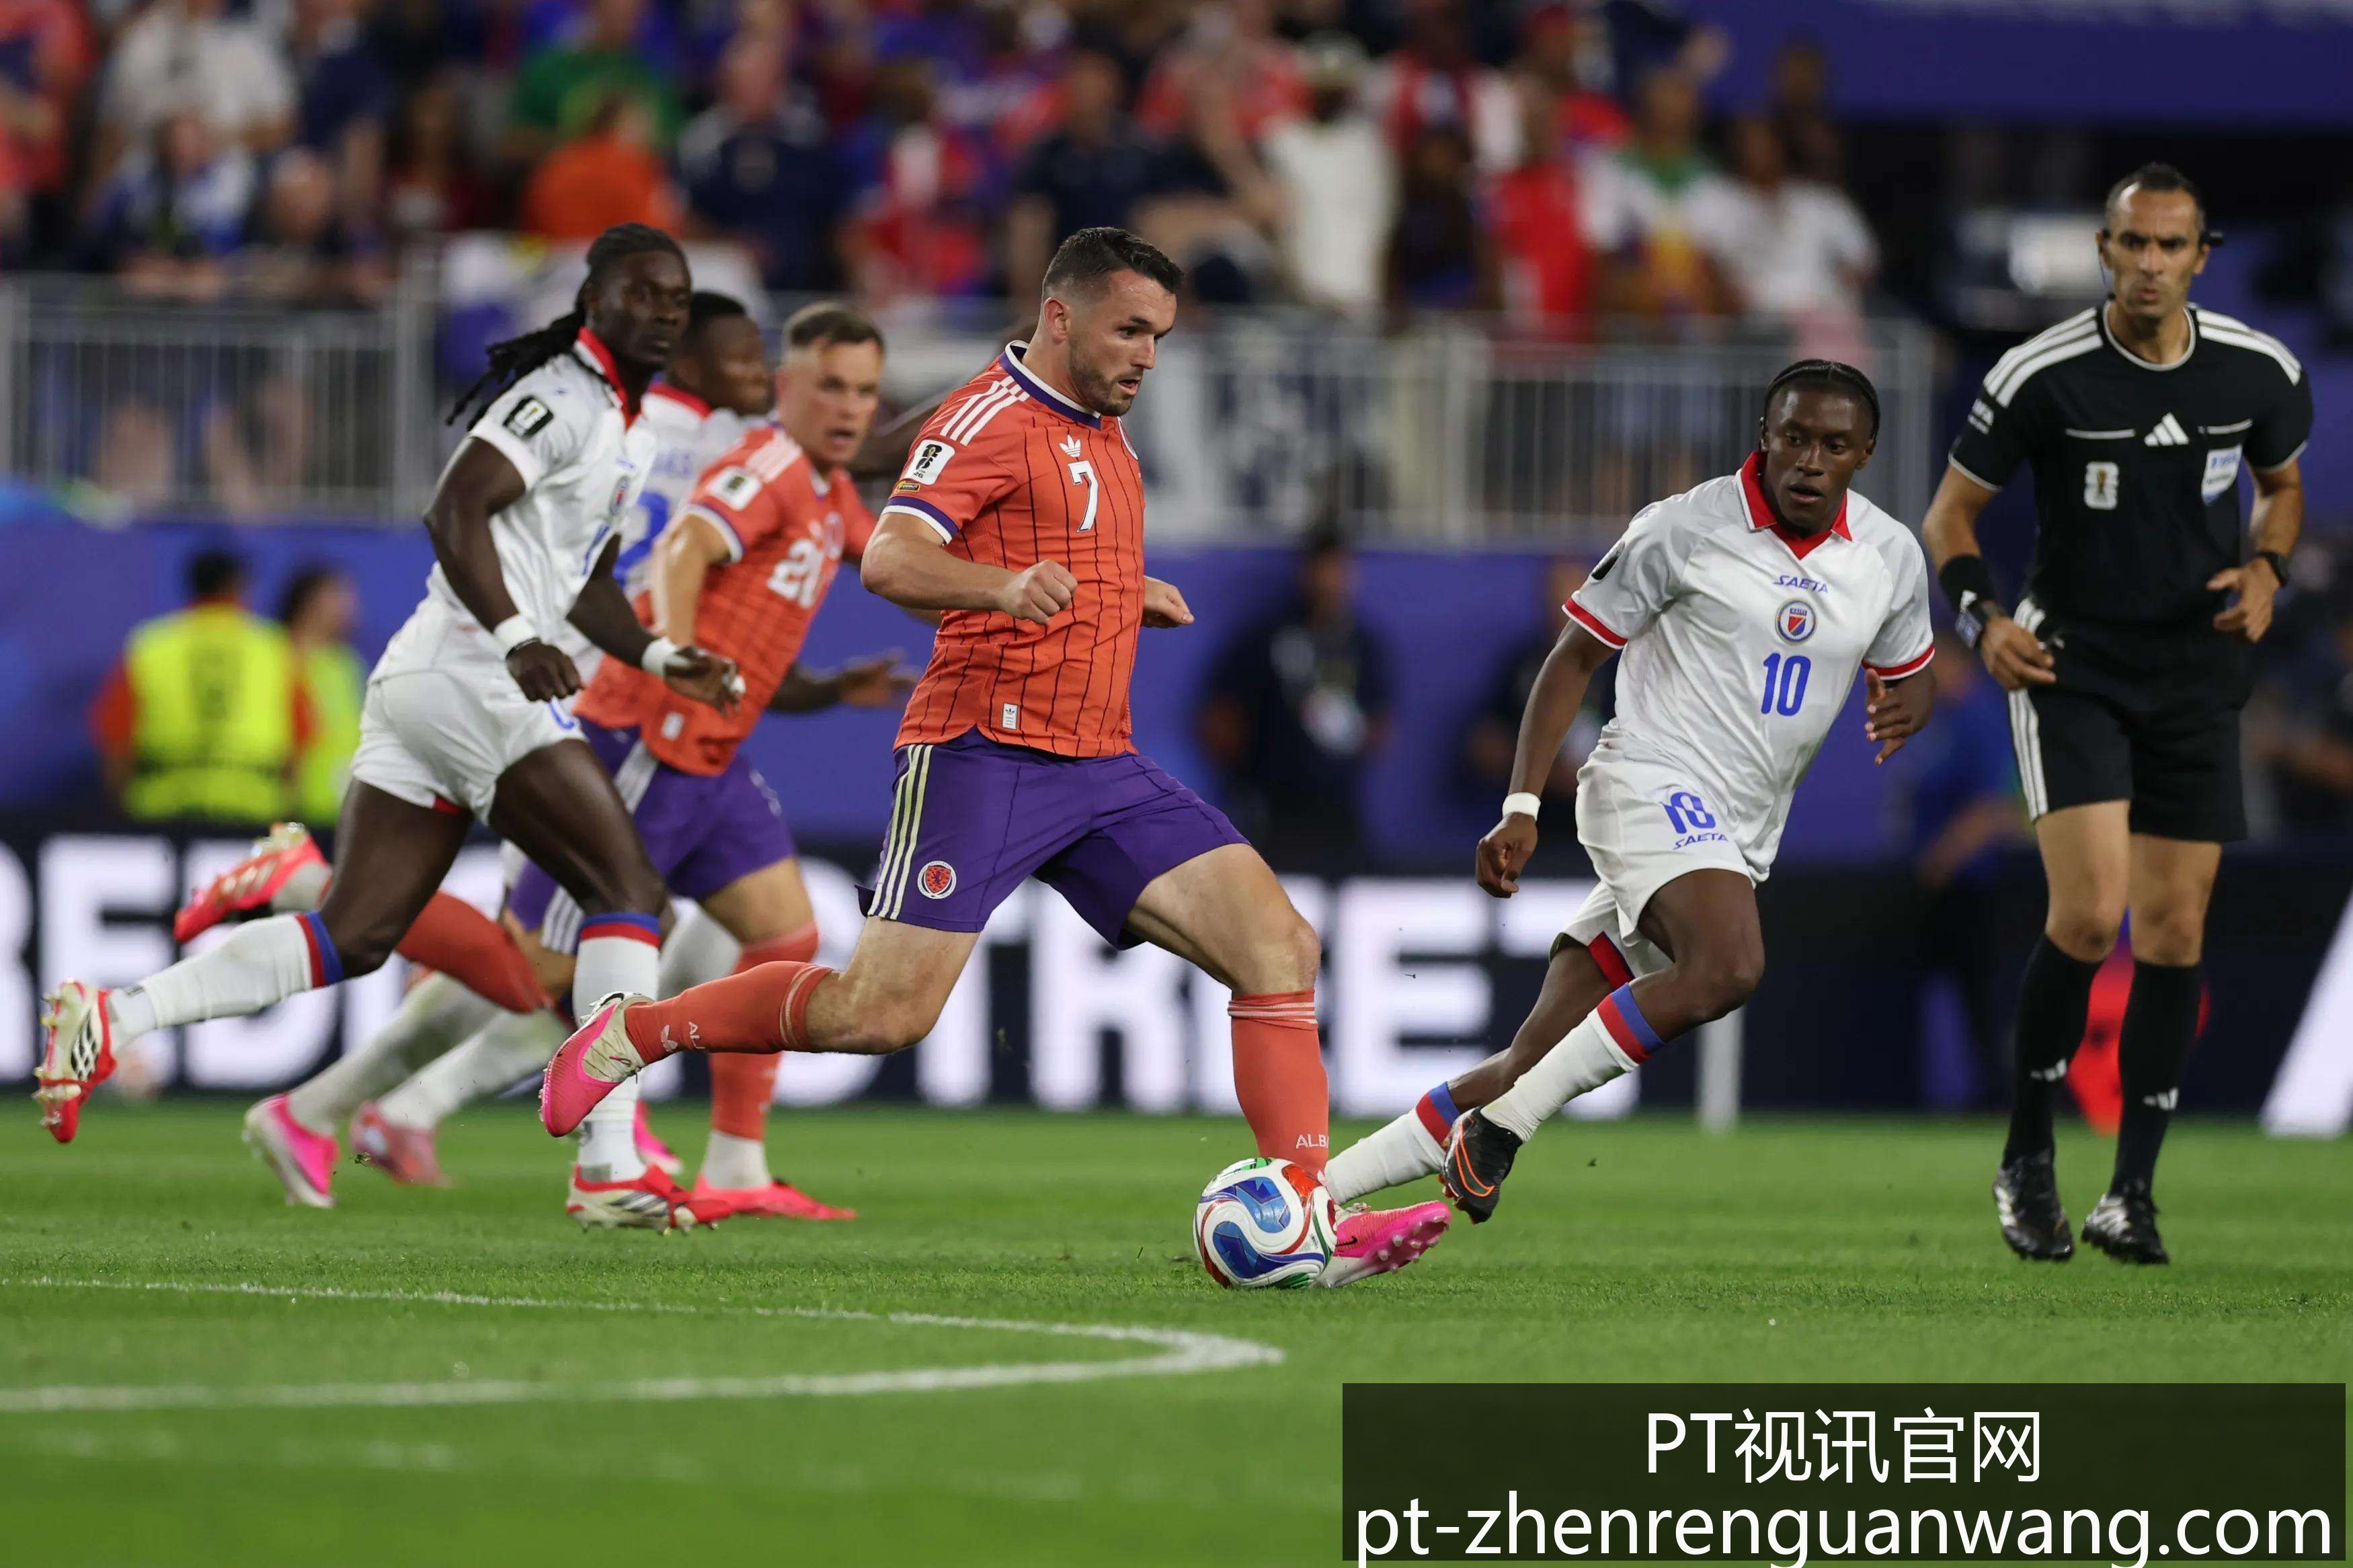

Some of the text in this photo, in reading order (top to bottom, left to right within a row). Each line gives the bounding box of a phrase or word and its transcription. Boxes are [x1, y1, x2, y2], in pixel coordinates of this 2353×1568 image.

[1068, 460, 1098, 532] 7
[1773, 575, 1828, 593] SAETA
[1761, 653, 1811, 716] 10
[1663, 792, 1716, 834] 10
[1672, 832, 1728, 850] SAETA
[688, 1021, 705, 1048] AL
[1295, 1133, 1329, 1149] ALB
